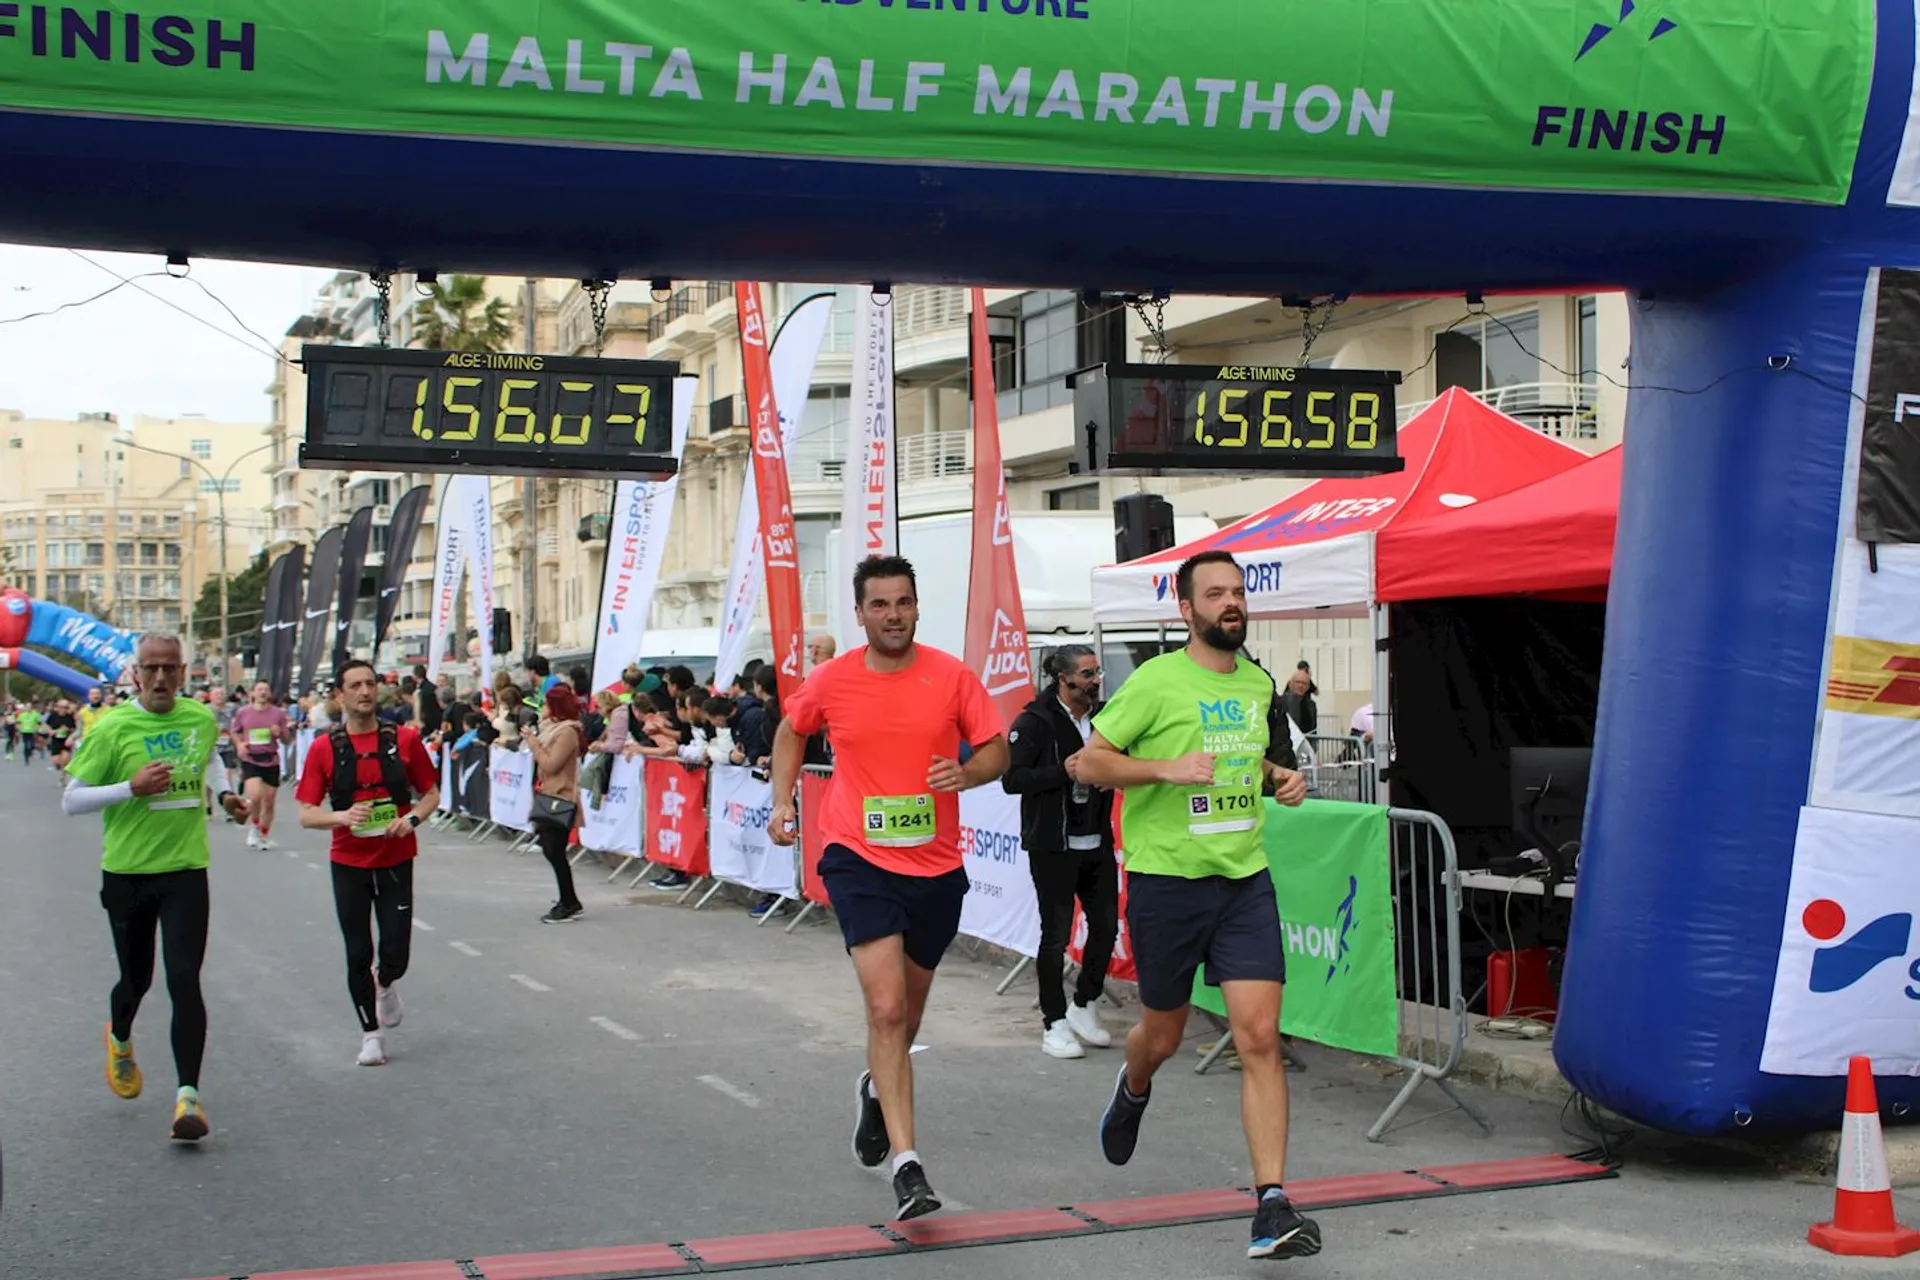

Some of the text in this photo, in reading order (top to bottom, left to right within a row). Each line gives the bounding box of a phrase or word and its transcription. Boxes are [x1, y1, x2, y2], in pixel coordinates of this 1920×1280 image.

[425, 29, 1394, 138] MALTA HALF MARATHON
[1531, 105, 1726, 155] FINISH
[443, 352, 545, 371] ALGE-TIMING
[1217, 366, 1296, 382] ALGE-TIMING
[1195, 389, 1380, 449] 1.56.58
[1288, 497, 1397, 525] INTER
[1216, 793, 1255, 811] 1701
[889, 812, 932, 829] 1241
